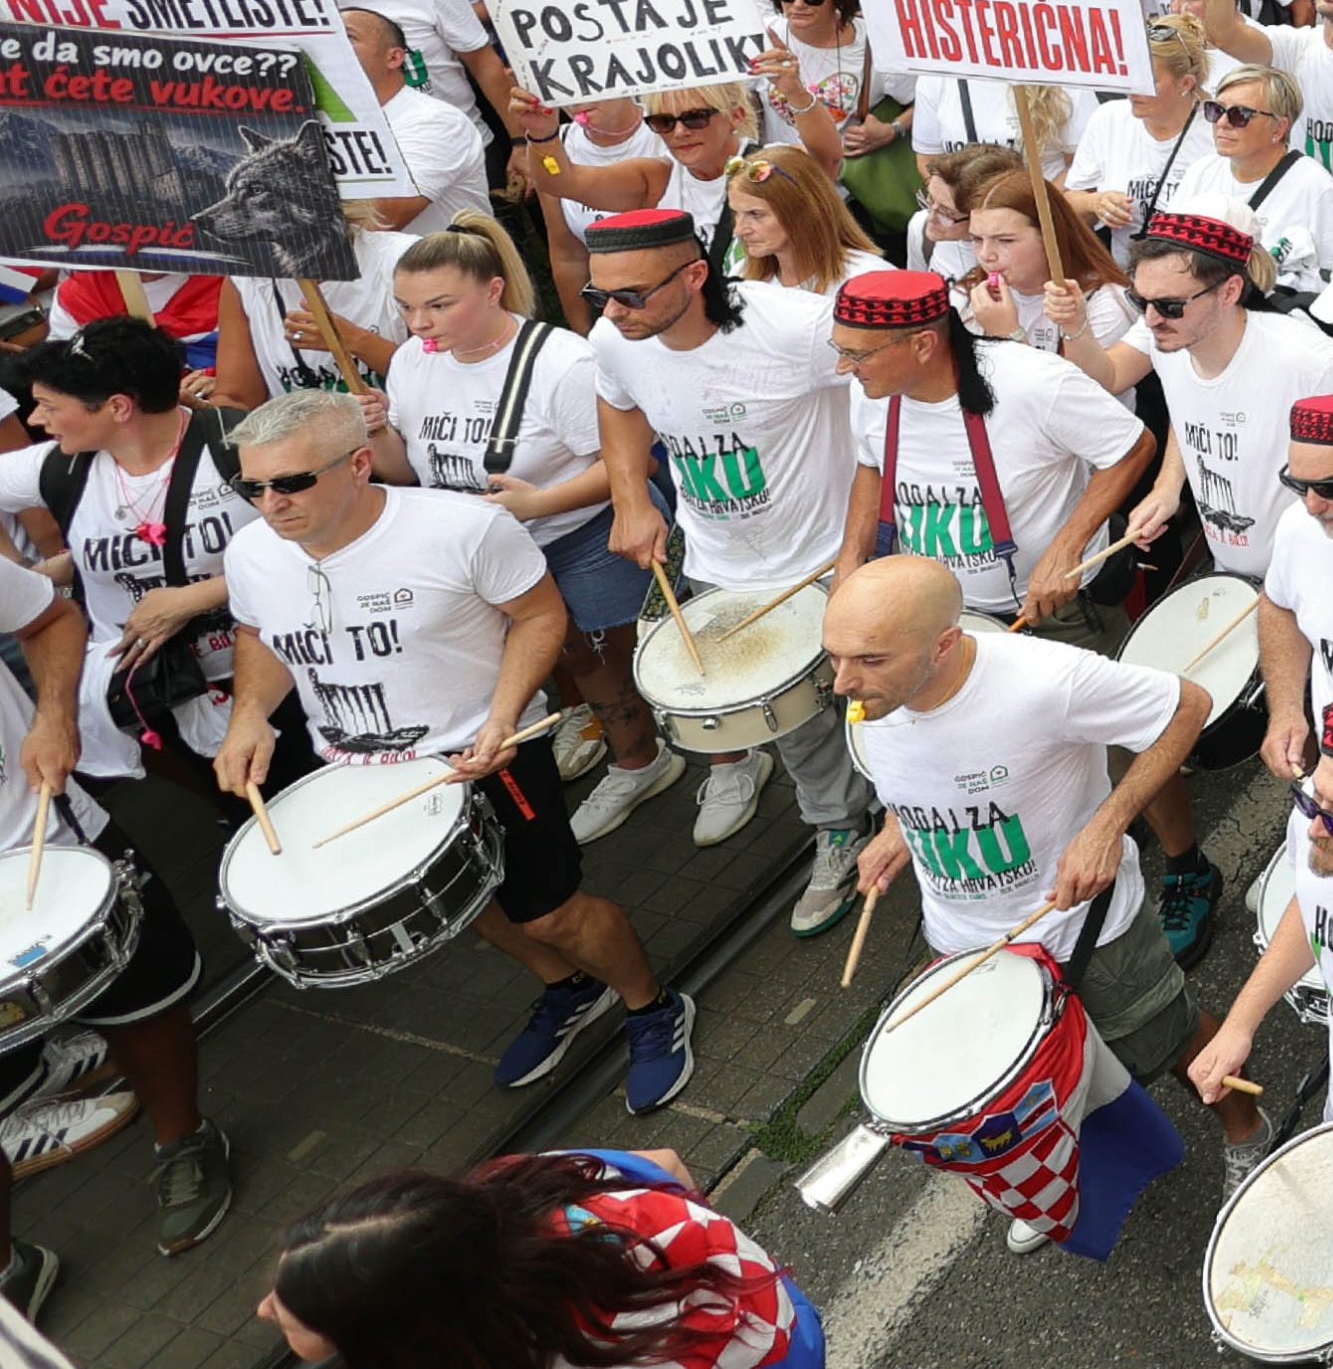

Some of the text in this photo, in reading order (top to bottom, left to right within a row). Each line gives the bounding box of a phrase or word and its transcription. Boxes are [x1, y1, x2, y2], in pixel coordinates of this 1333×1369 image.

[32, 31, 298, 79] da smo ovce??
[43, 63, 305, 115] ćete vukove.
[42, 201, 198, 255] Gospić
[418, 410, 492, 445] MIČI TO!
[713, 431, 751, 456] ZA
[1185, 421, 1240, 461] MIČI TO!
[184, 511, 236, 561] TO!
[272, 619, 403, 666] MIČI TO!
[888, 800, 1011, 835] HODAJ ZA
[959, 859, 1038, 894] HRVATSKU!
